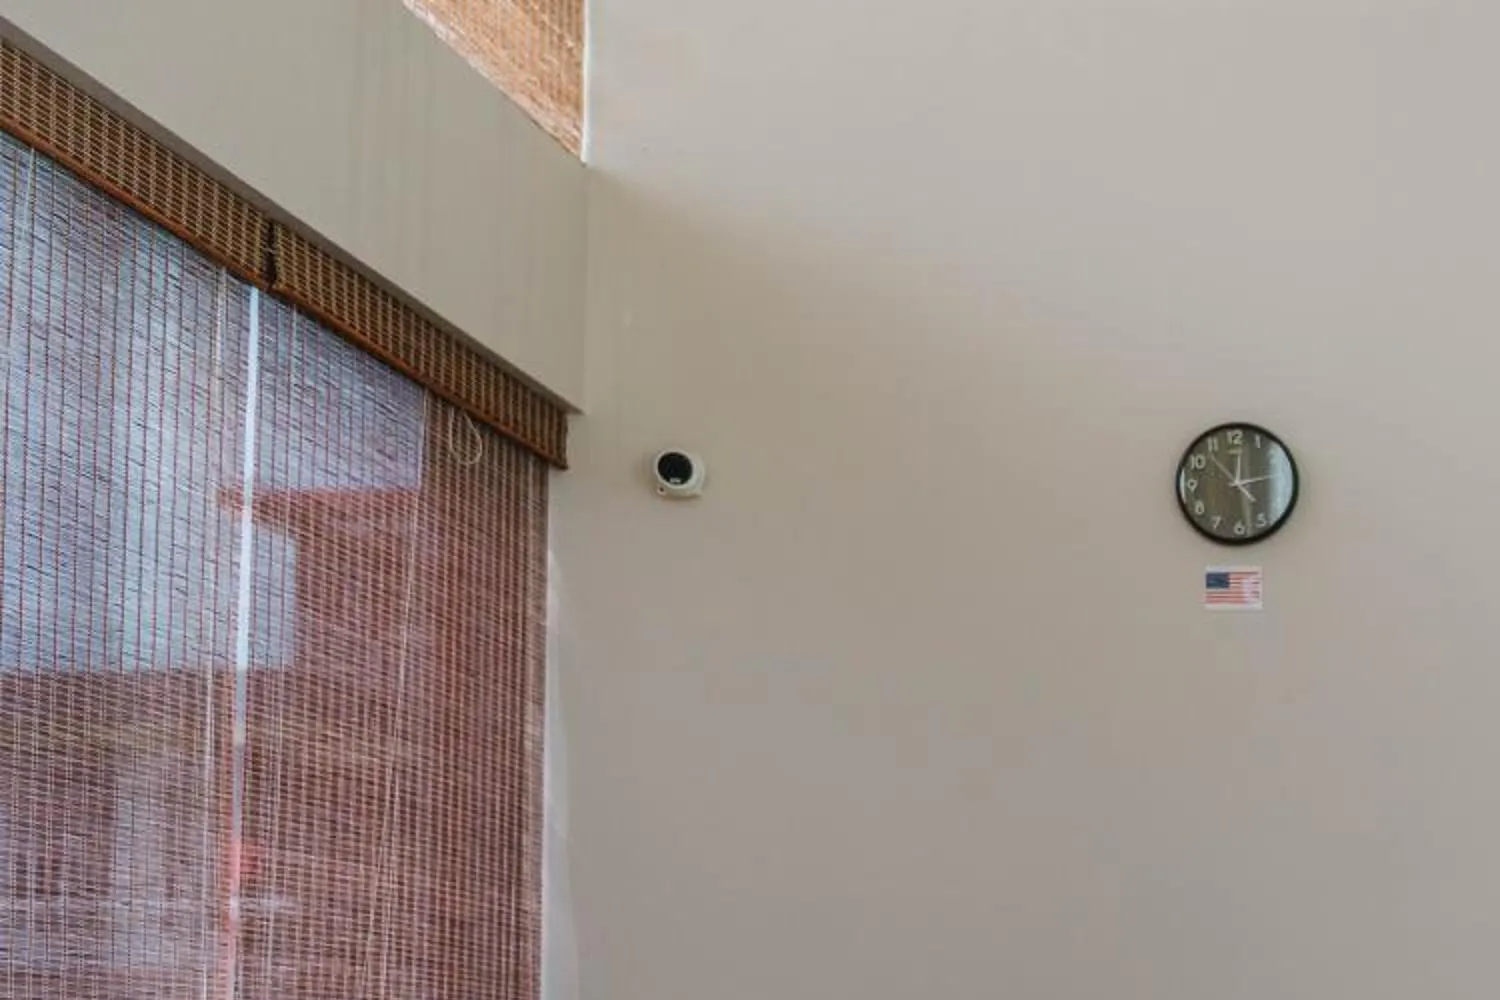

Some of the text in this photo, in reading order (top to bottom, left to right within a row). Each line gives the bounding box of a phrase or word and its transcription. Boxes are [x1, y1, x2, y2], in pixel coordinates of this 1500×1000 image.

[1227, 431, 1243, 445] 12
[1208, 439, 1219, 452] 11
[1191, 455, 1206, 469] 10
[1187, 479, 1197, 492] 9
[1212, 516, 1221, 529] 7
[1257, 513, 1267, 527] 5
[1234, 521, 1245, 535] 6
